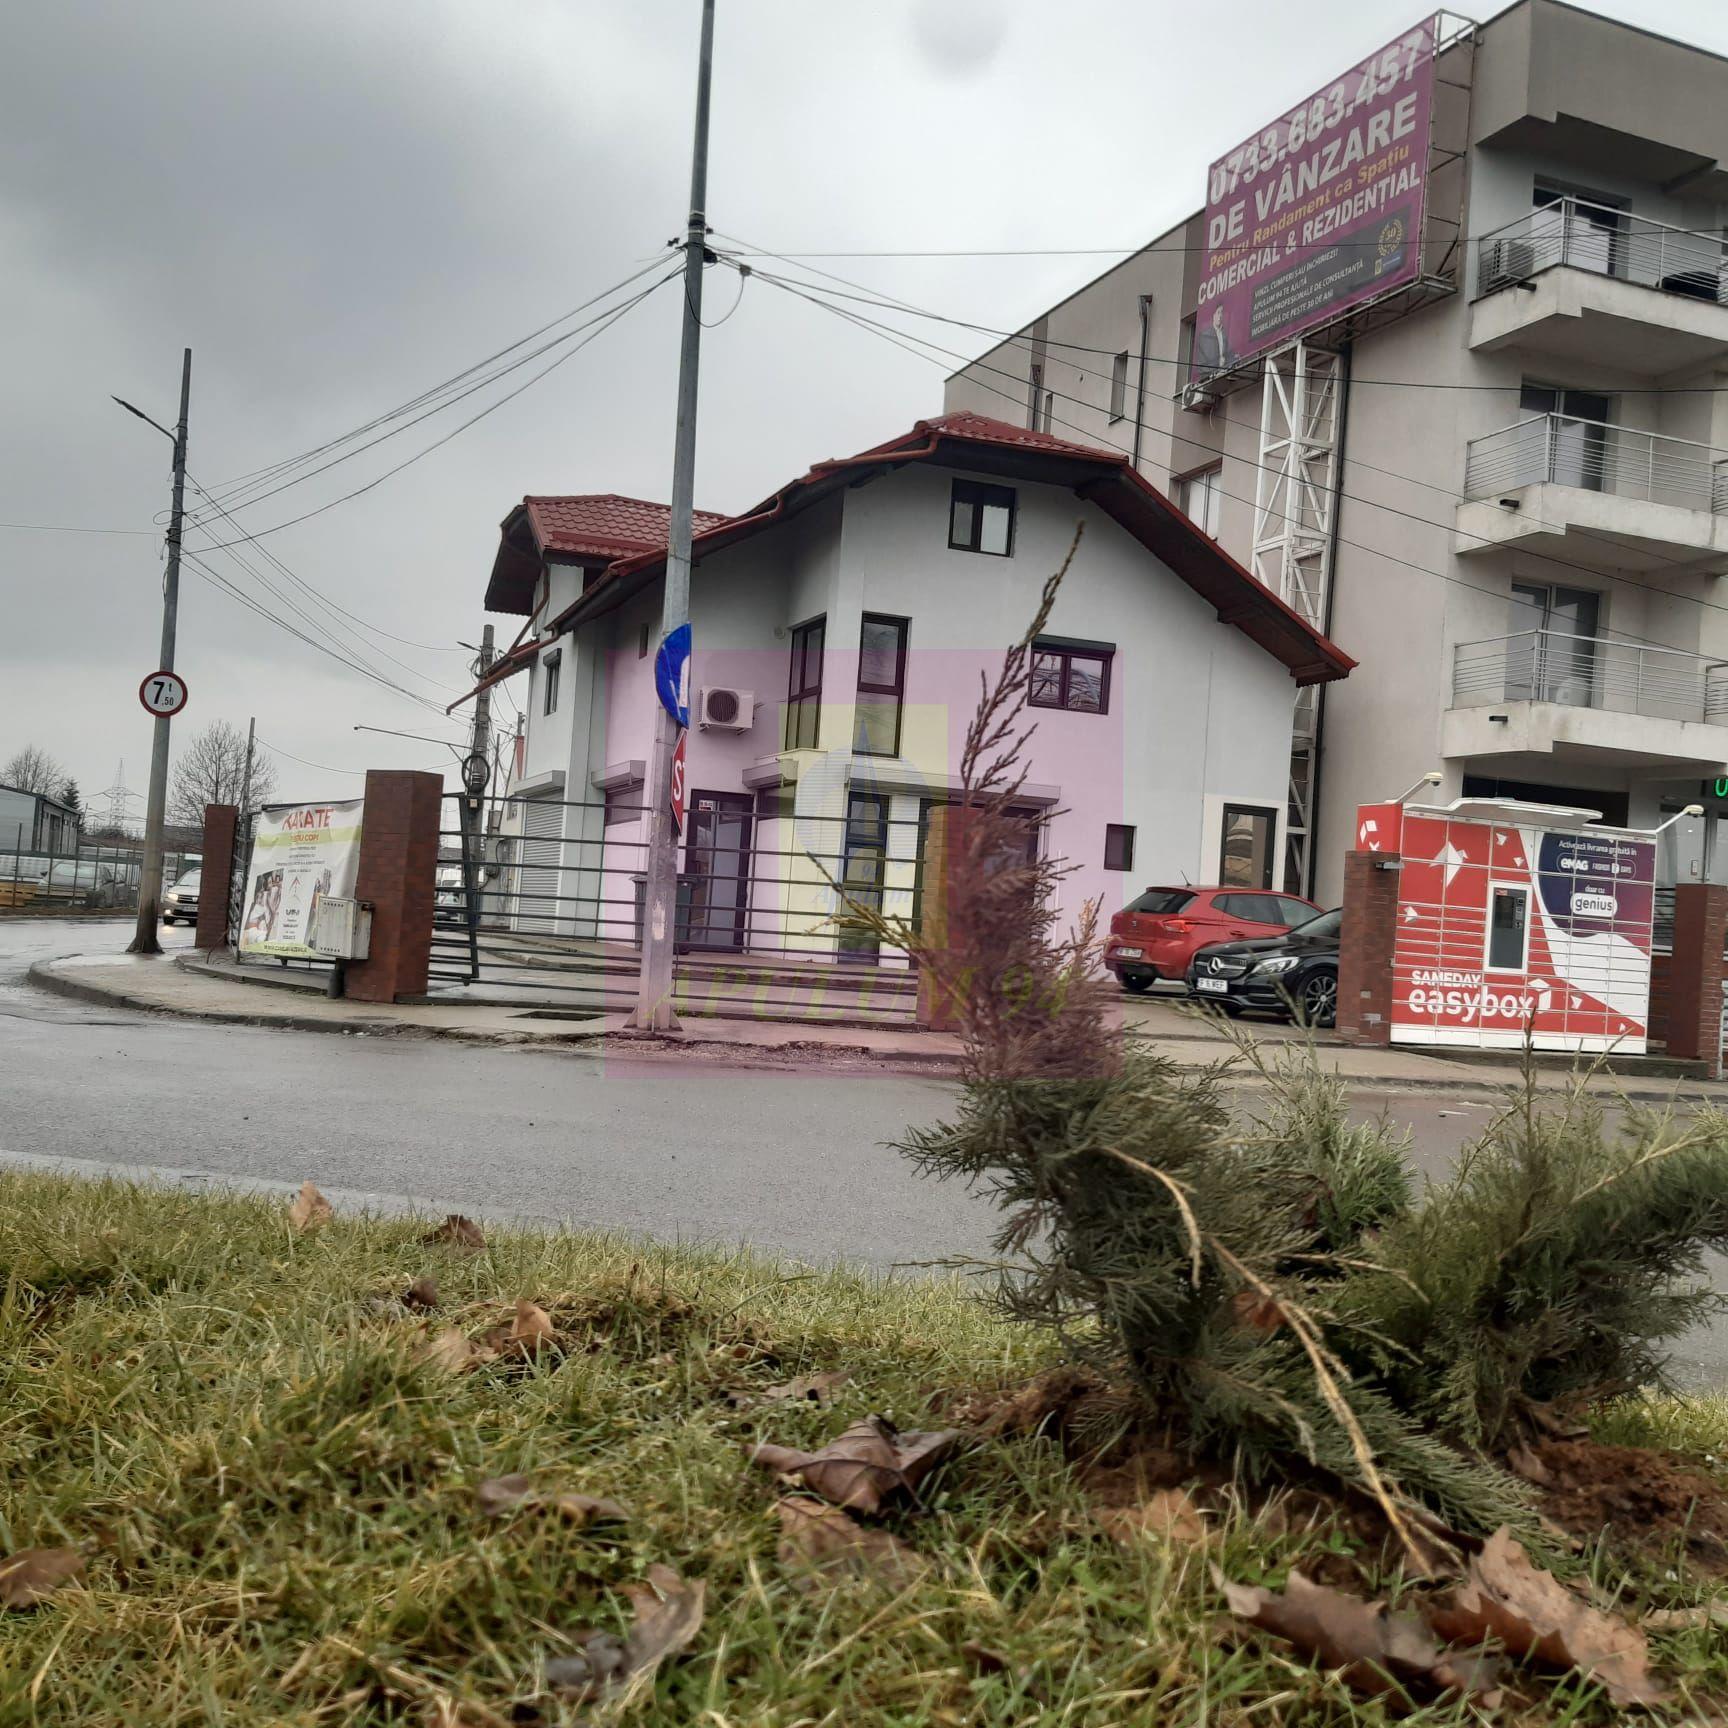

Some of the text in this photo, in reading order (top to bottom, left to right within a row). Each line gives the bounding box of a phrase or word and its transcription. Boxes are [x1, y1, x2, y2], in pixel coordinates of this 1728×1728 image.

[1210, 30, 1424, 206] 0733.683.457
[1208, 92, 1418, 252] DE VÂNZARE
[1209, 239, 1249, 272] Pentru
[1253, 189, 1331, 246] Randament
[1334, 177, 1353, 197] ca
[1197, 240, 1281, 305] COMERCIAL
[1285, 230, 1297, 255] &
[153, 681, 165, 704] 7
[1575, 897, 1613, 911] genius
[1408, 985, 1534, 1023] easybox
[1411, 970, 1481, 988] SAMEDAY
